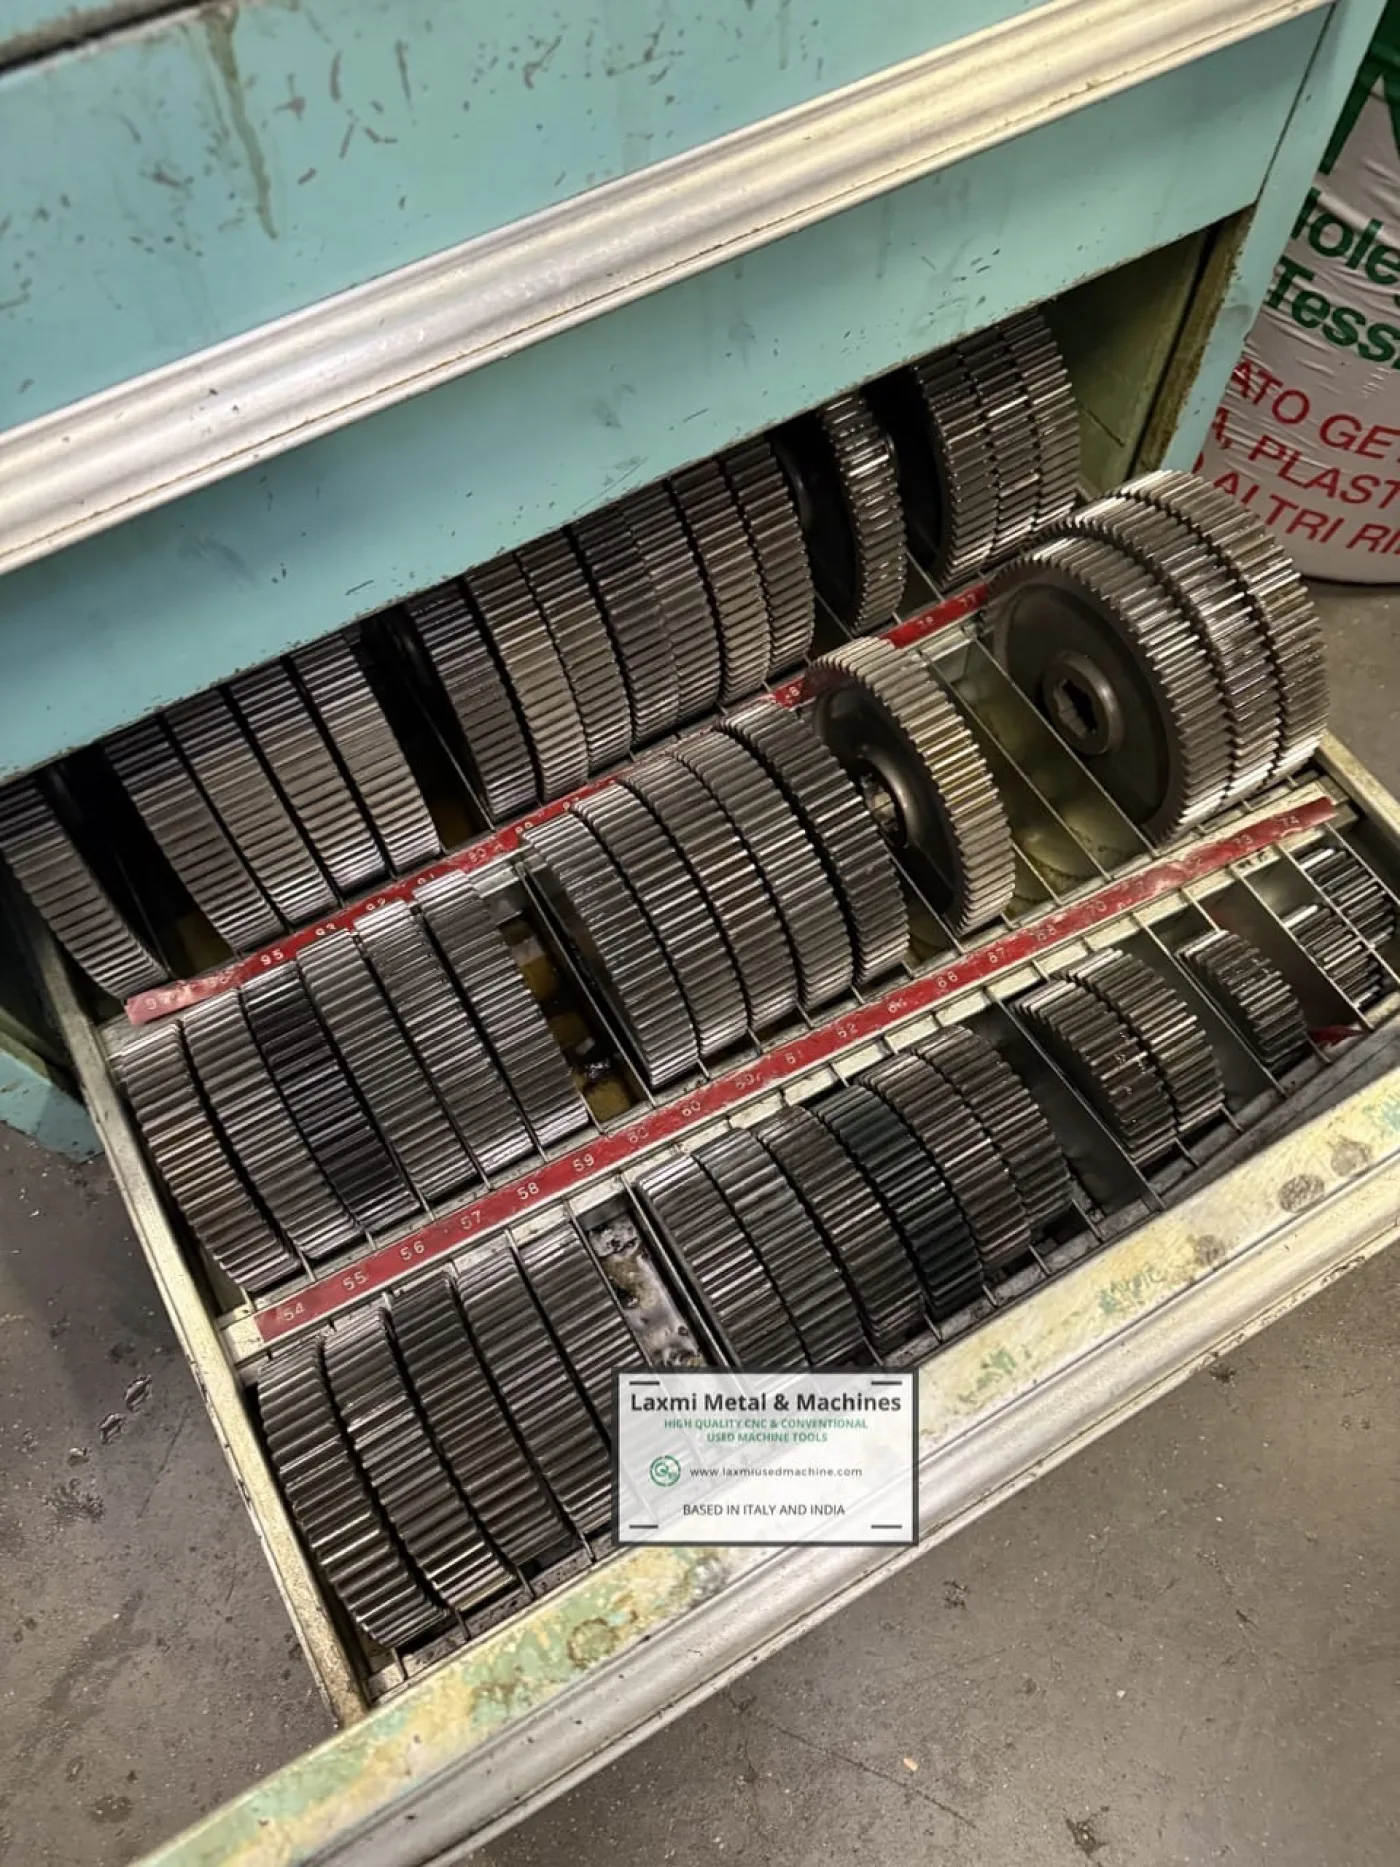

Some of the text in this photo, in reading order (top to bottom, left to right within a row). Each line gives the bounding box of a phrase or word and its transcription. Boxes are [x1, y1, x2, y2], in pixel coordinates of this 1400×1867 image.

[1264, 254, 1400, 371] Tess
[260, 948, 284, 966] 95
[282, 1303, 304, 1321] 54
[343, 1271, 368, 1290] 55
[400, 1240, 425, 1260] 56
[460, 1210, 481, 1230] 57
[517, 1182, 539, 1200] 58
[572, 1153, 595, 1172] 59
[987, 947, 1004, 964] 67
